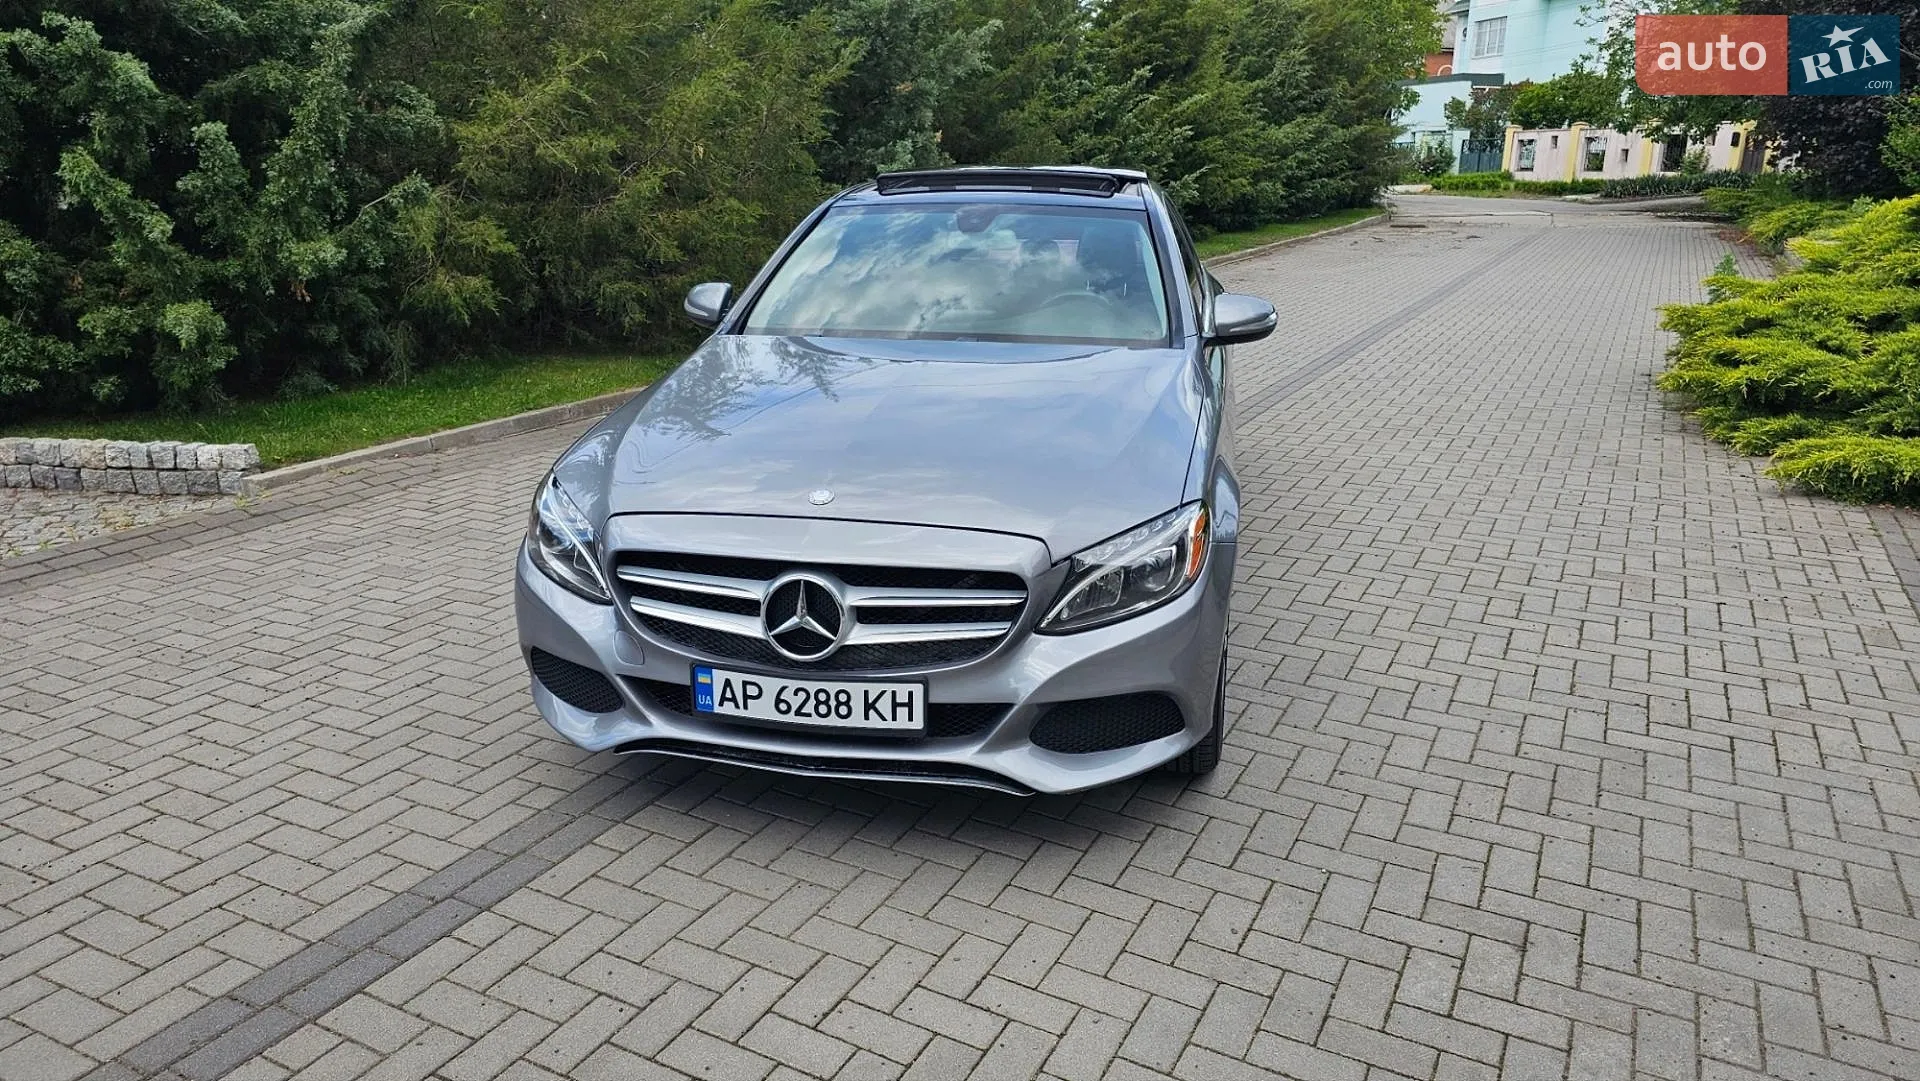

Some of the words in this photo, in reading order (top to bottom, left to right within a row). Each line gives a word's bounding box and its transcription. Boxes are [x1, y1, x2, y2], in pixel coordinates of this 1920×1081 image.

[698, 694, 712, 705] UA
[718, 678, 763, 709] AP
[774, 685, 852, 719] 6288
[863, 689, 913, 721] KH
